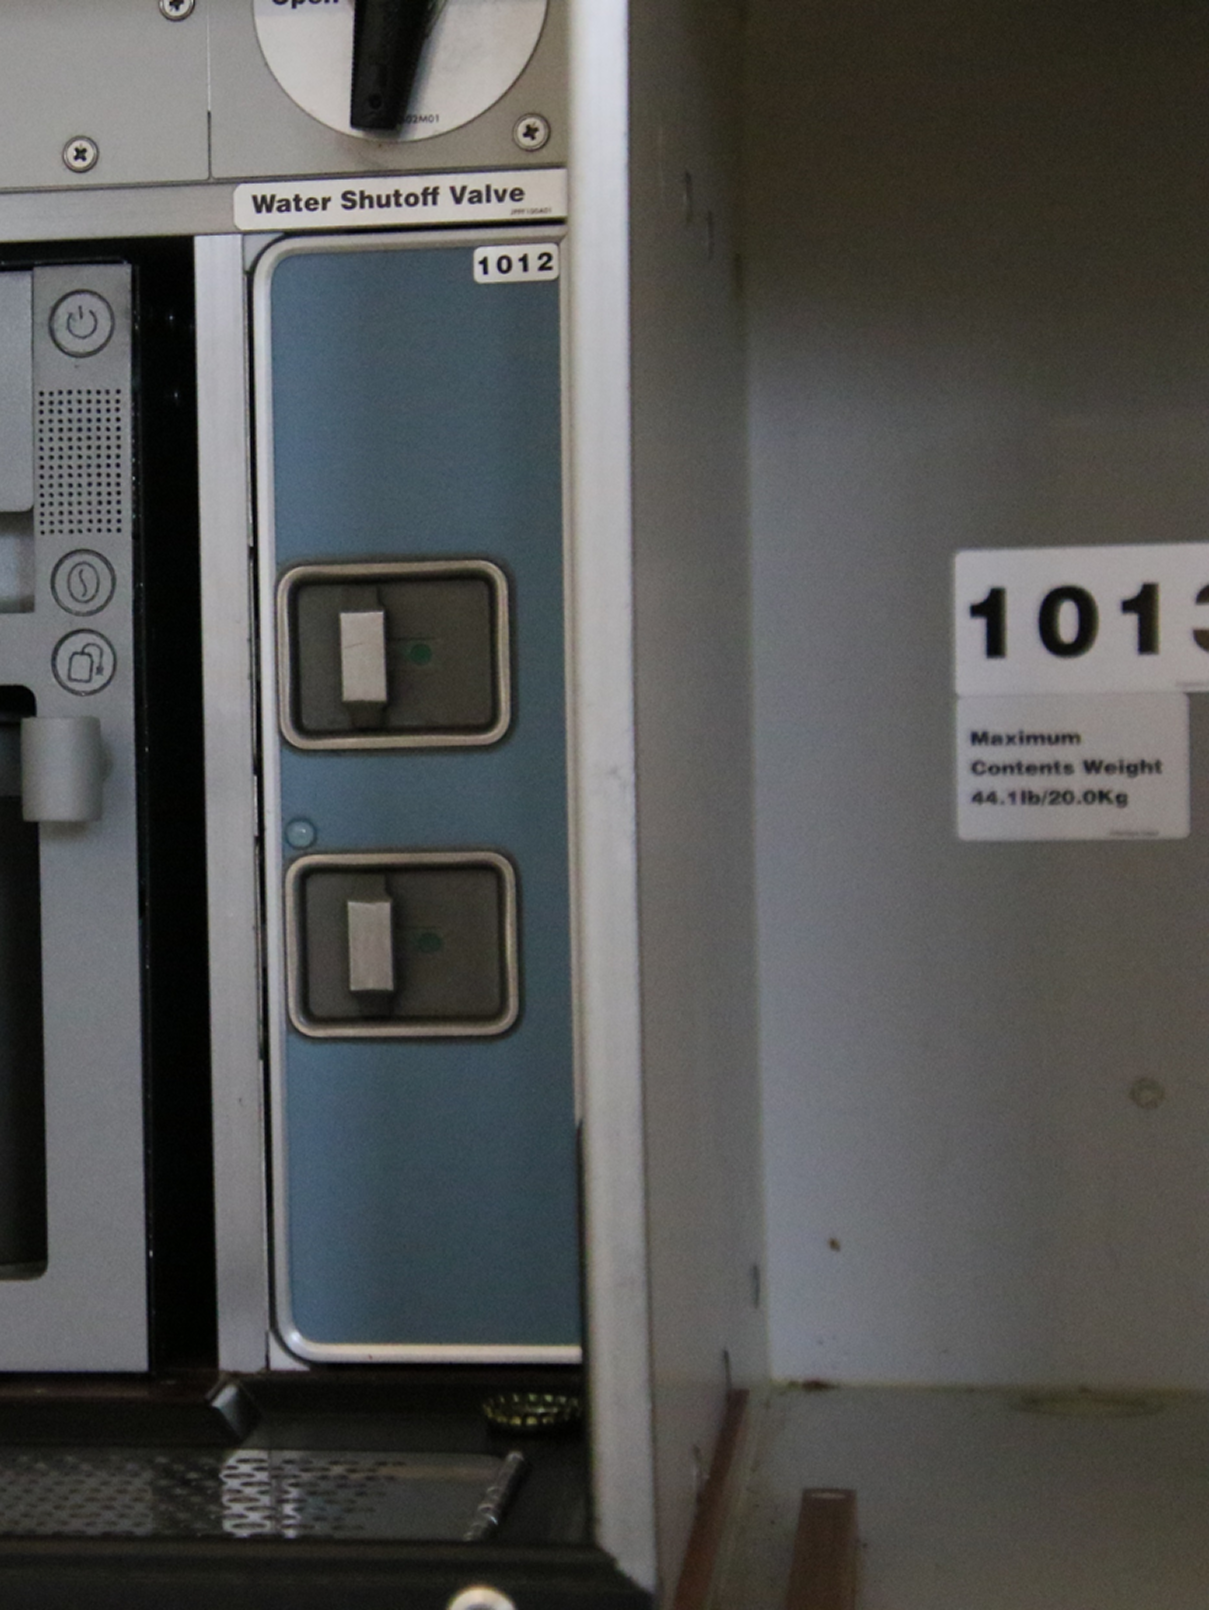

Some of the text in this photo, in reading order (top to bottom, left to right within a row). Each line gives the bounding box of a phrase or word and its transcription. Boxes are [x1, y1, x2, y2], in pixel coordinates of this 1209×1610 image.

[252, 184, 525, 214] Water Shutoff Valve
[478, 252, 553, 275] 1012
[970, 730, 1082, 747] Maximum
[970, 758, 1163, 779] Contents Weight
[970, 790, 1130, 809] 44.1lb/20.0Kg
